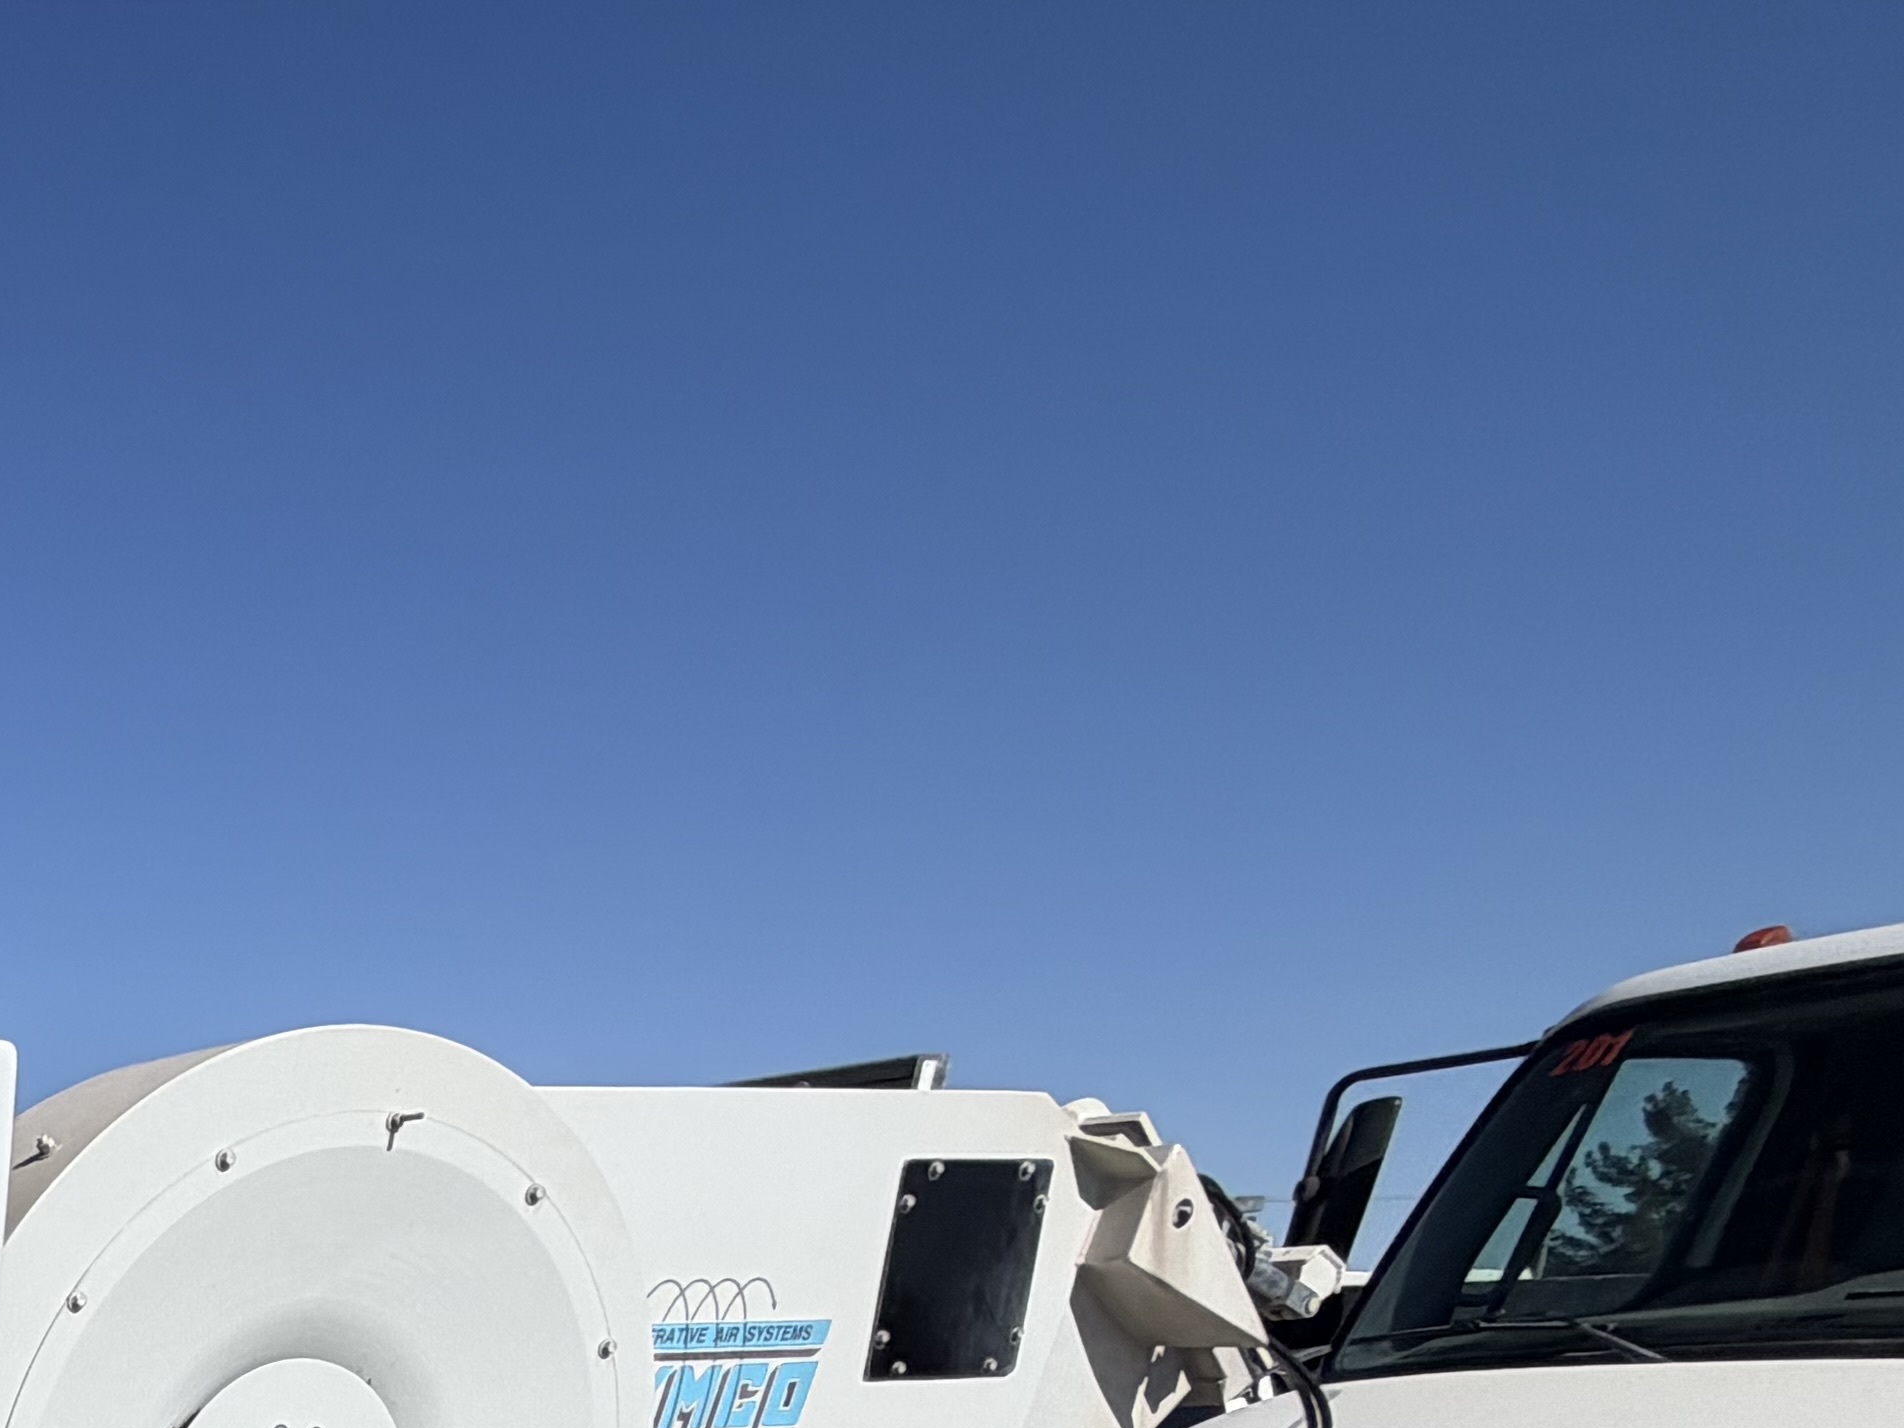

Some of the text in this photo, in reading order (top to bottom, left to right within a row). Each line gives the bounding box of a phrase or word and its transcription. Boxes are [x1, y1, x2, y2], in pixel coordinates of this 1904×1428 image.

[652, 1324, 814, 1346] RATIVE AIR SYSTEMS
